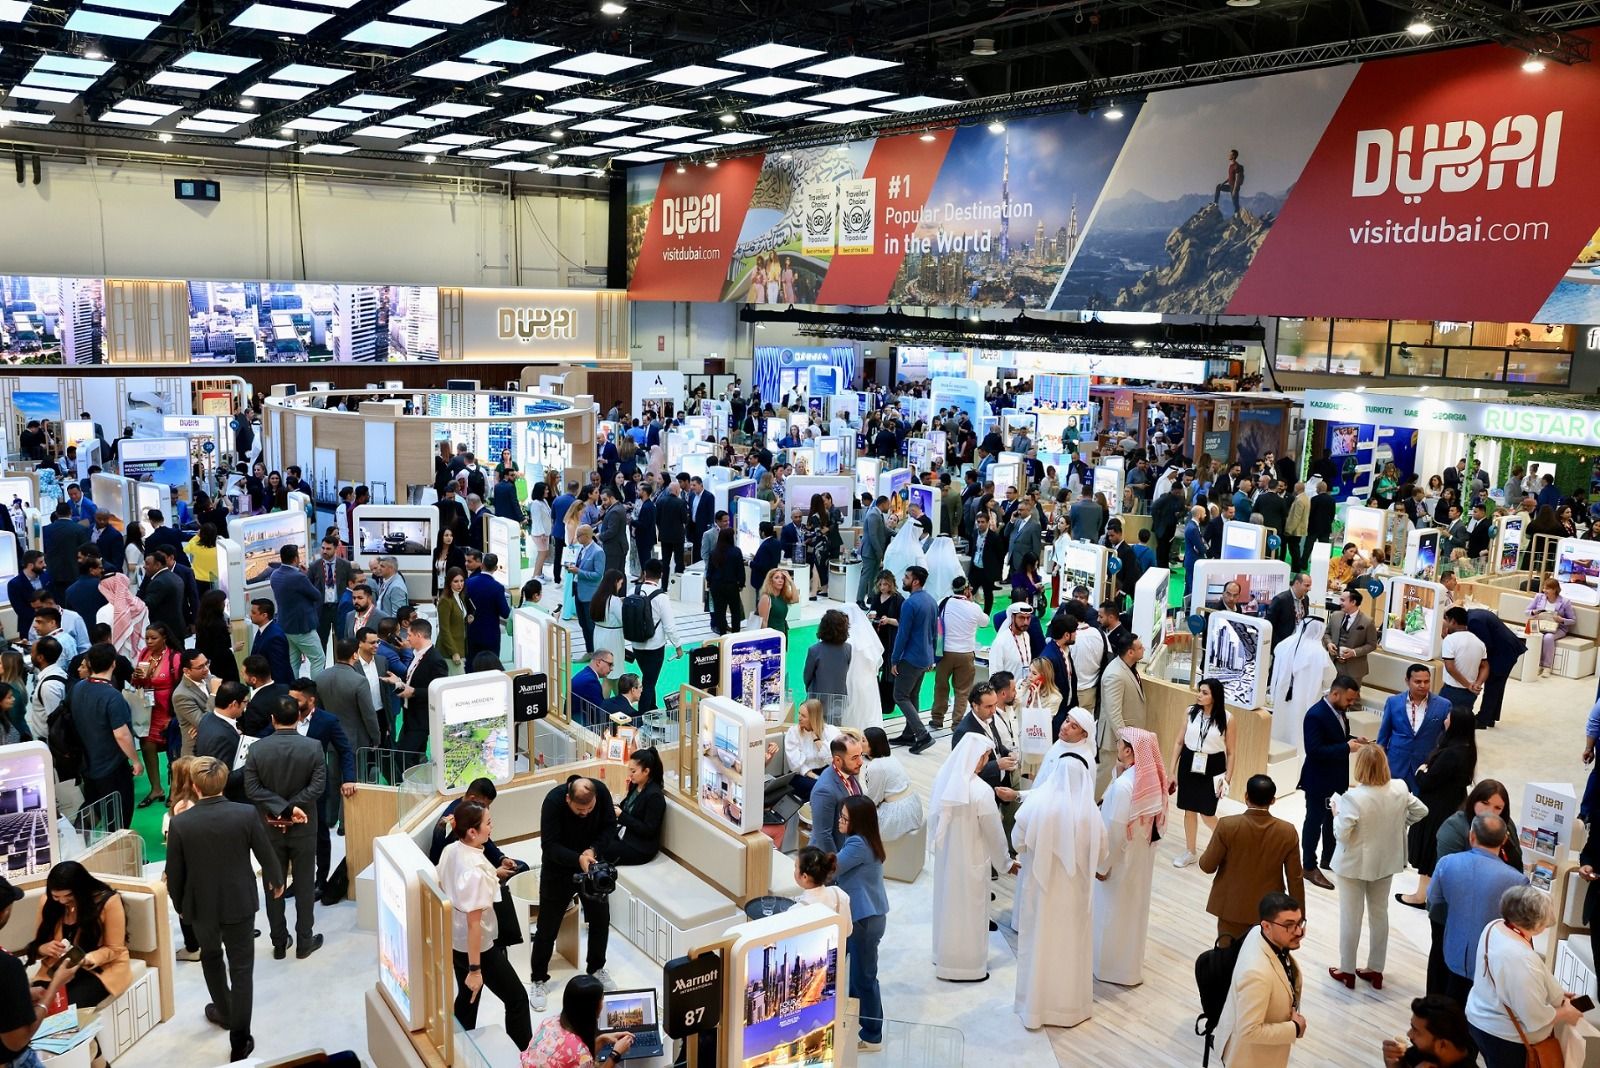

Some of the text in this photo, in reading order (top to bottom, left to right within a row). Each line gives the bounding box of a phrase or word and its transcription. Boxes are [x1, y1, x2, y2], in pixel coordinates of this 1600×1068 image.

[1351, 110, 1564, 205] DUBAI
[888, 174, 911, 199] #1
[811, 201, 828, 209] Choice
[848, 197, 866, 206] Choice
[662, 193, 721, 240] DUBAI
[885, 199, 1033, 229] Popular Destination
[1349, 215, 1549, 245] visitdubai.com
[884, 229, 992, 255] in the World
[662, 246, 720, 261] visitdubai.com
[498, 308, 577, 342] DUBAI
[1404, 408, 1418, 418] UAE
[1485, 409, 1586, 438] RUSTAR
[1370, 584, 1379, 593] 77
[694, 653, 718, 665] Marriott
[518, 682, 546, 694] Marriott
[700, 674, 712, 684] 82
[526, 704, 540, 716] 85
[1535, 793, 1564, 811] DUBAI
[672, 969, 719, 993] Marriott
[684, 1006, 706, 1026] 87
